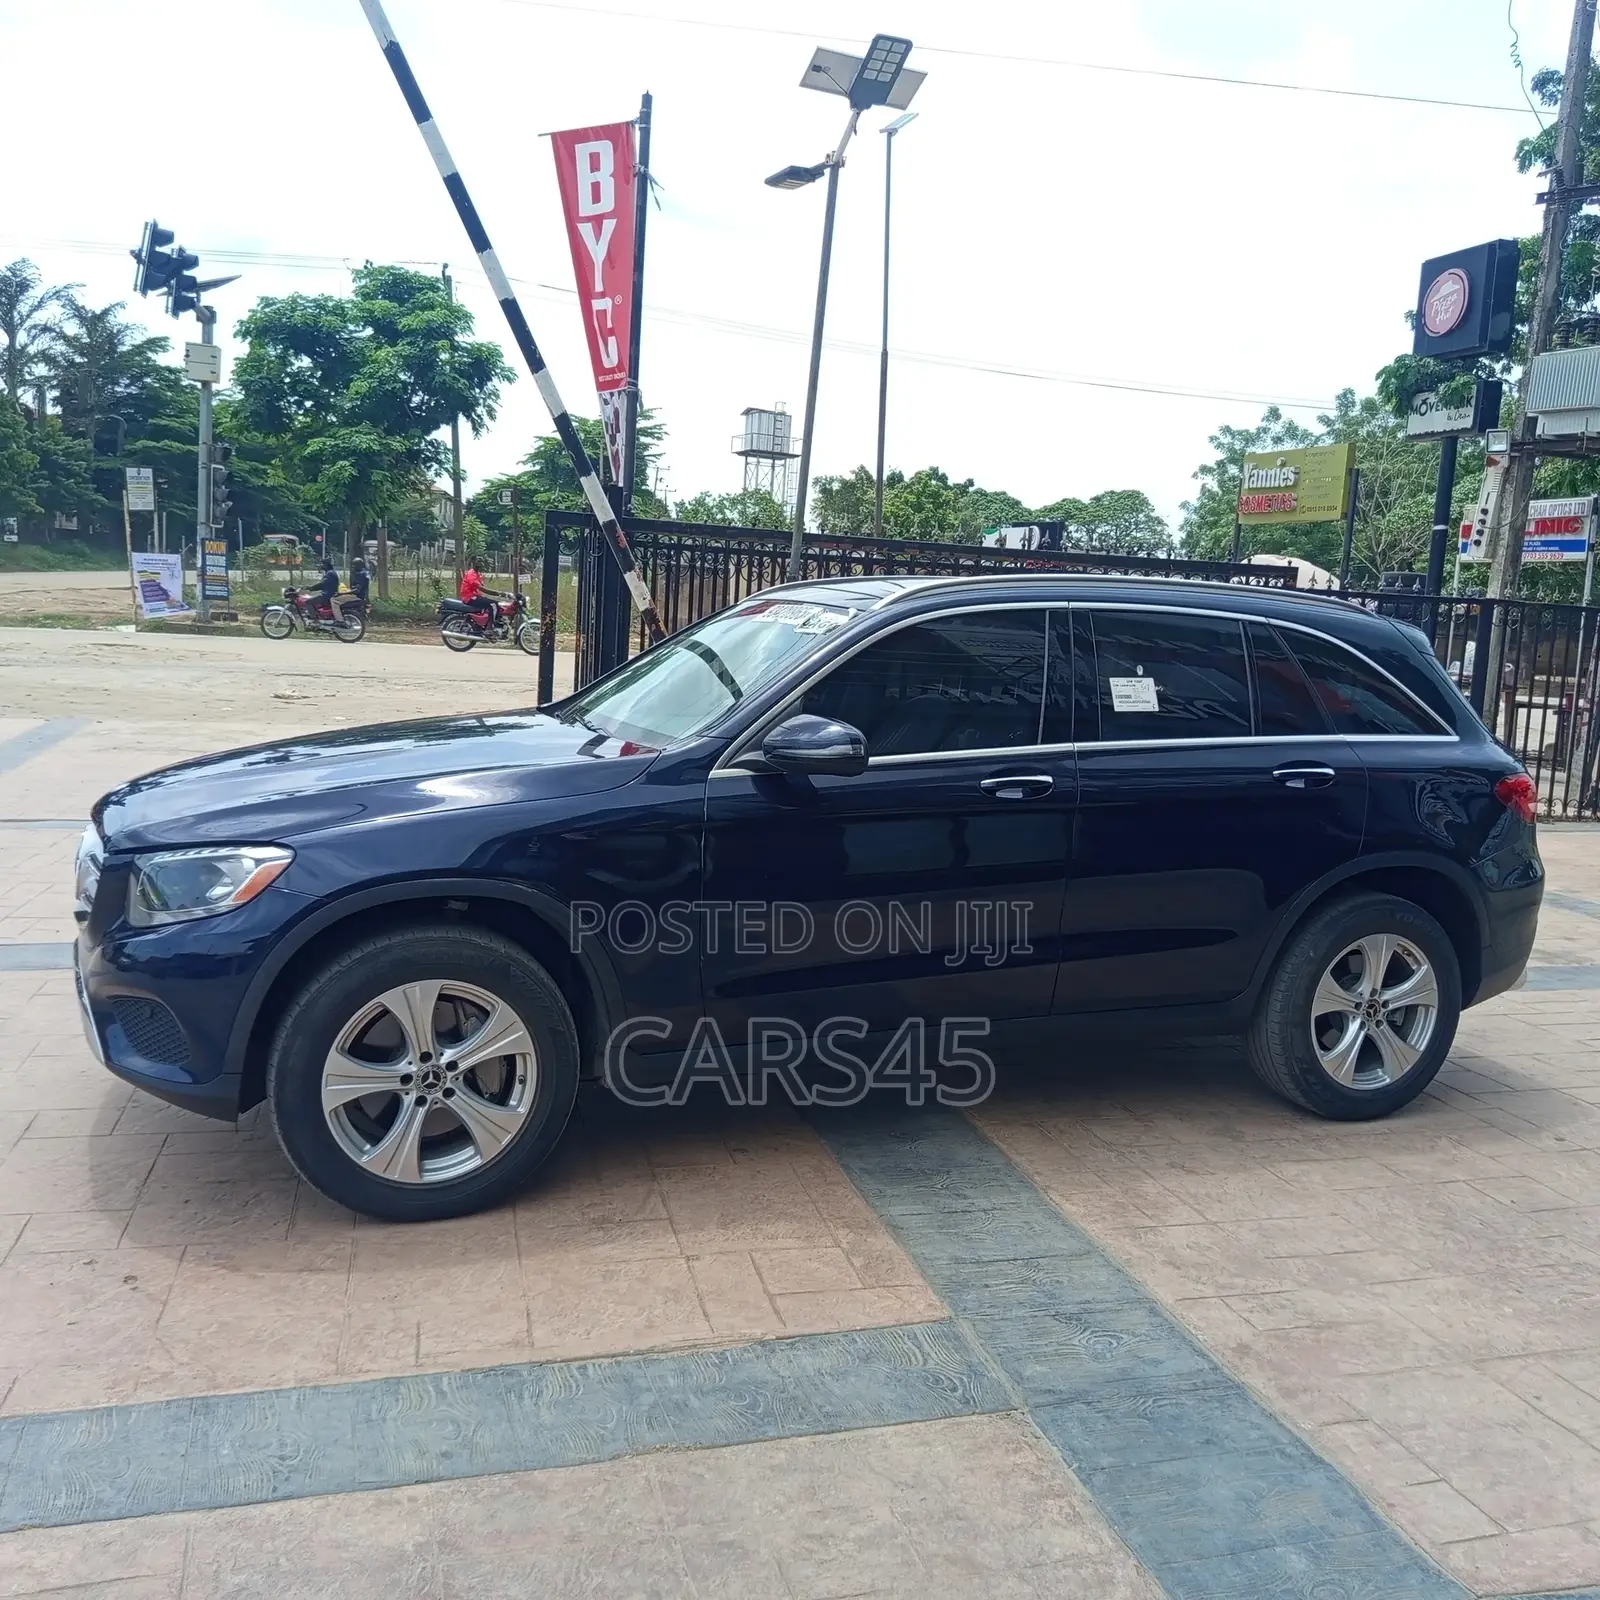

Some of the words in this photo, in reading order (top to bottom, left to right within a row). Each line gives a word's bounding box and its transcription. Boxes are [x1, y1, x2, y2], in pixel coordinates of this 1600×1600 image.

[1431, 293, 1457, 317] Pizza
[1435, 305, 1454, 325] Hut
[1243, 457, 1298, 489] Yannies
[1239, 492, 1297, 513] COSMETICS
[1548, 502, 1572, 516] OPTICS
[1574, 501, 1587, 515] LTD
